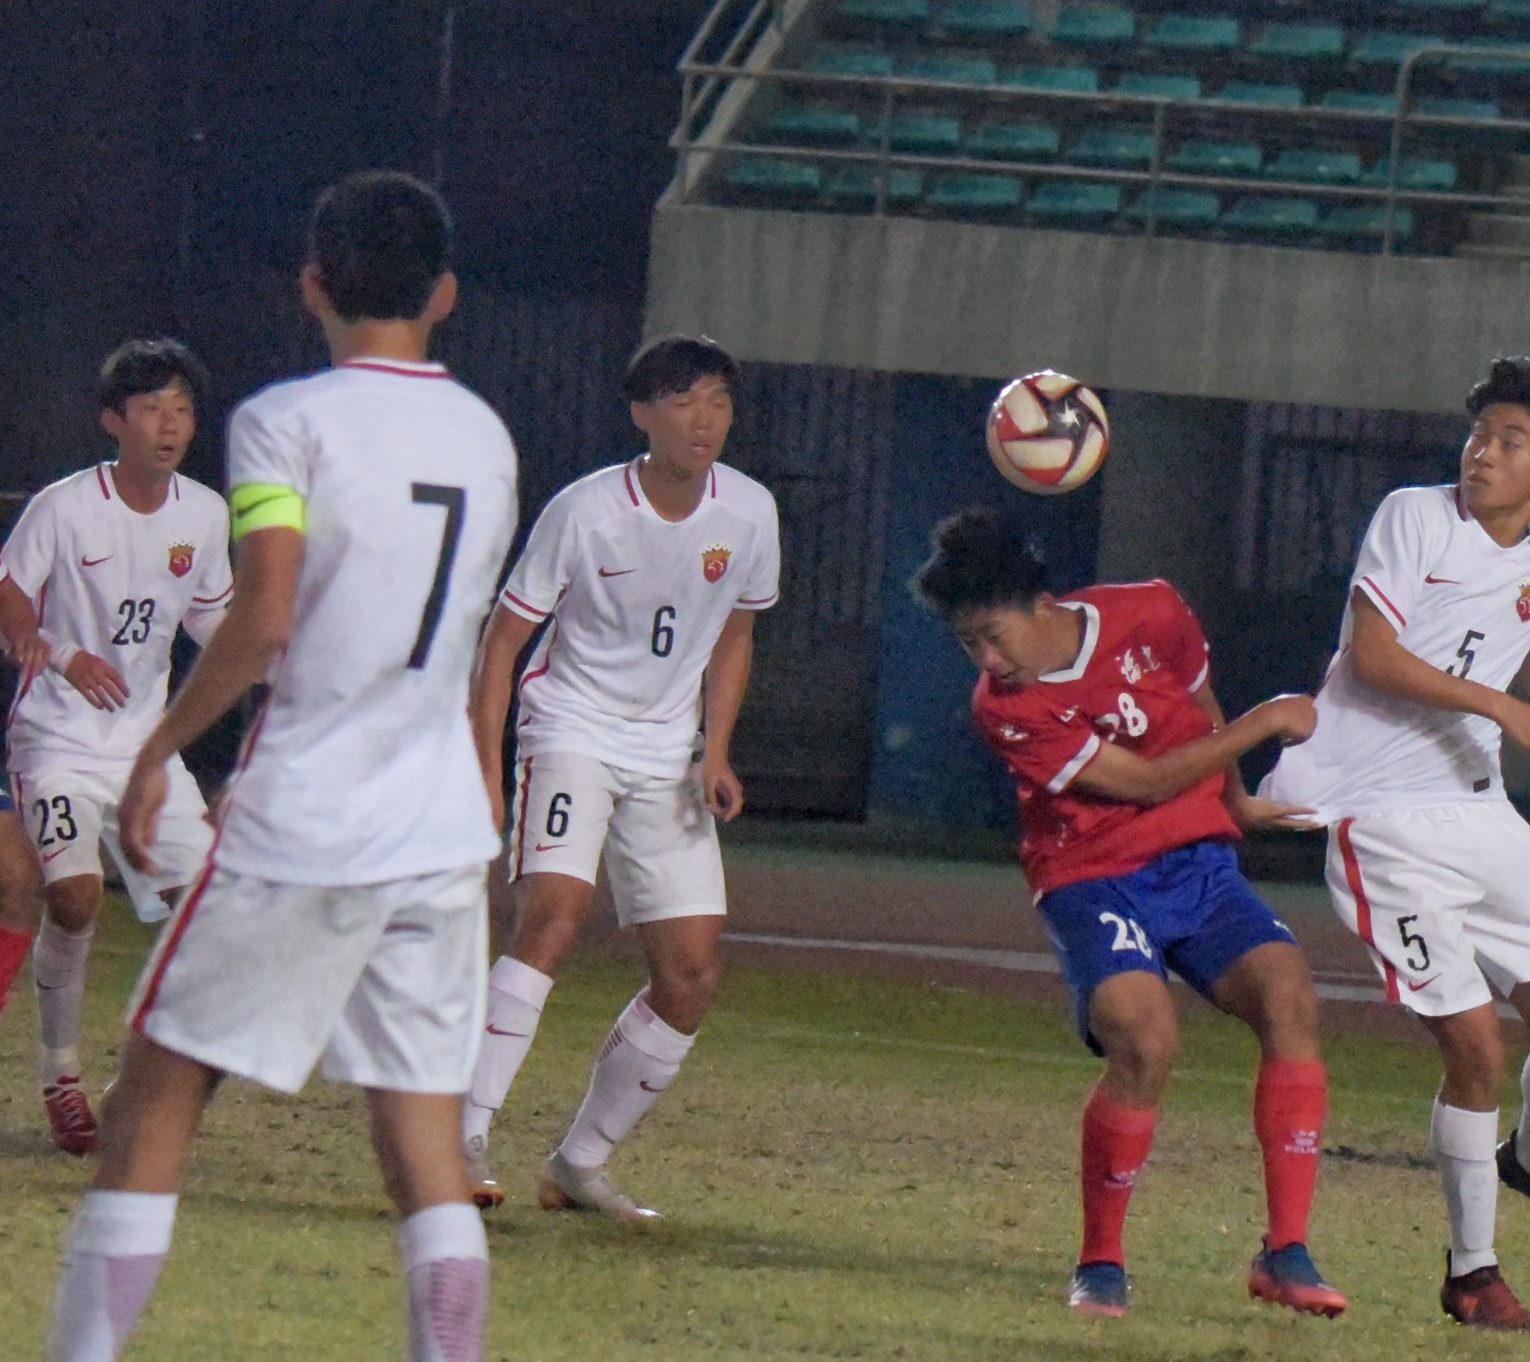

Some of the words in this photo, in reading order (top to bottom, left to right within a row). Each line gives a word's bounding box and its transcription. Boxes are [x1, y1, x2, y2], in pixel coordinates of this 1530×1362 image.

[408, 481, 467, 670] 7
[112, 598, 156, 646] 23
[650, 605, 677, 658] 6
[1446, 630, 1485, 680] 5
[32, 795, 78, 847] 23
[546, 792, 573, 838] 6
[1396, 915, 1431, 972] 5
